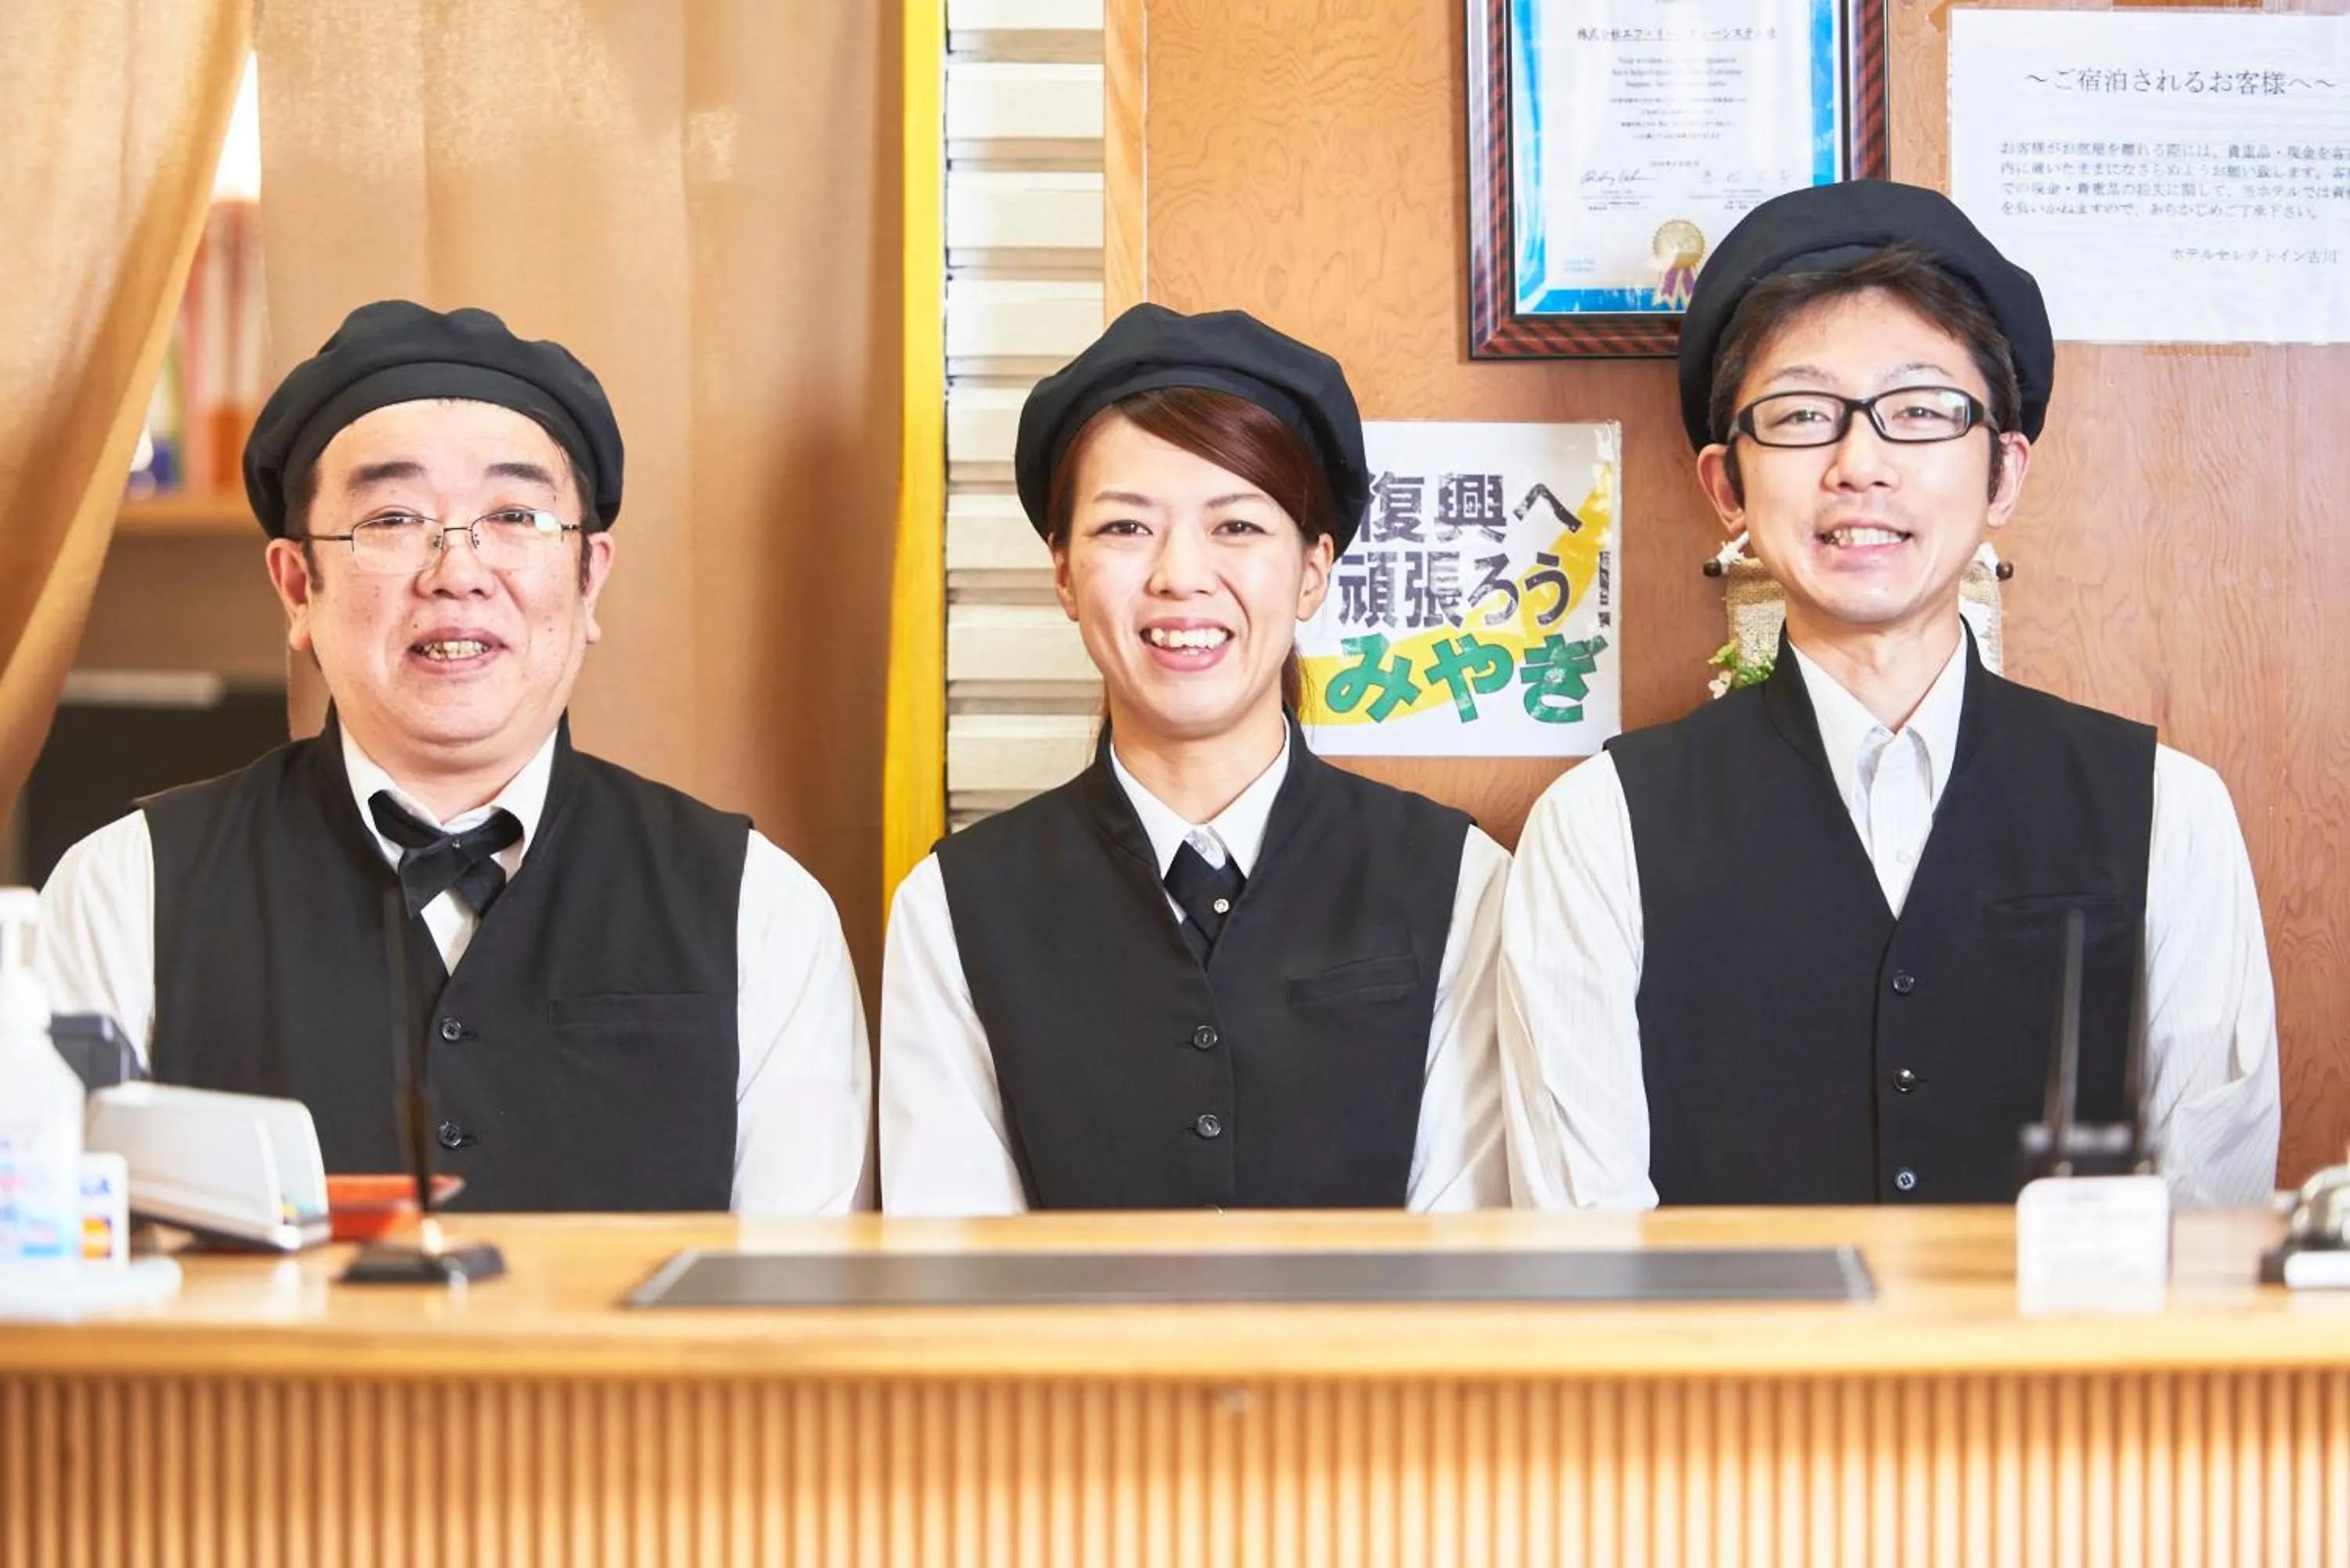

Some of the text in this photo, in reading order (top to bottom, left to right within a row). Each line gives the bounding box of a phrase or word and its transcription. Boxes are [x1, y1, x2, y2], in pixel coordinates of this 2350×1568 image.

[2025, 67, 2337, 96] ～ご宿泊されるお客様へ～
[1360, 471, 1582, 544] 復興へ
[1325, 632, 1608, 724] みやぎ
